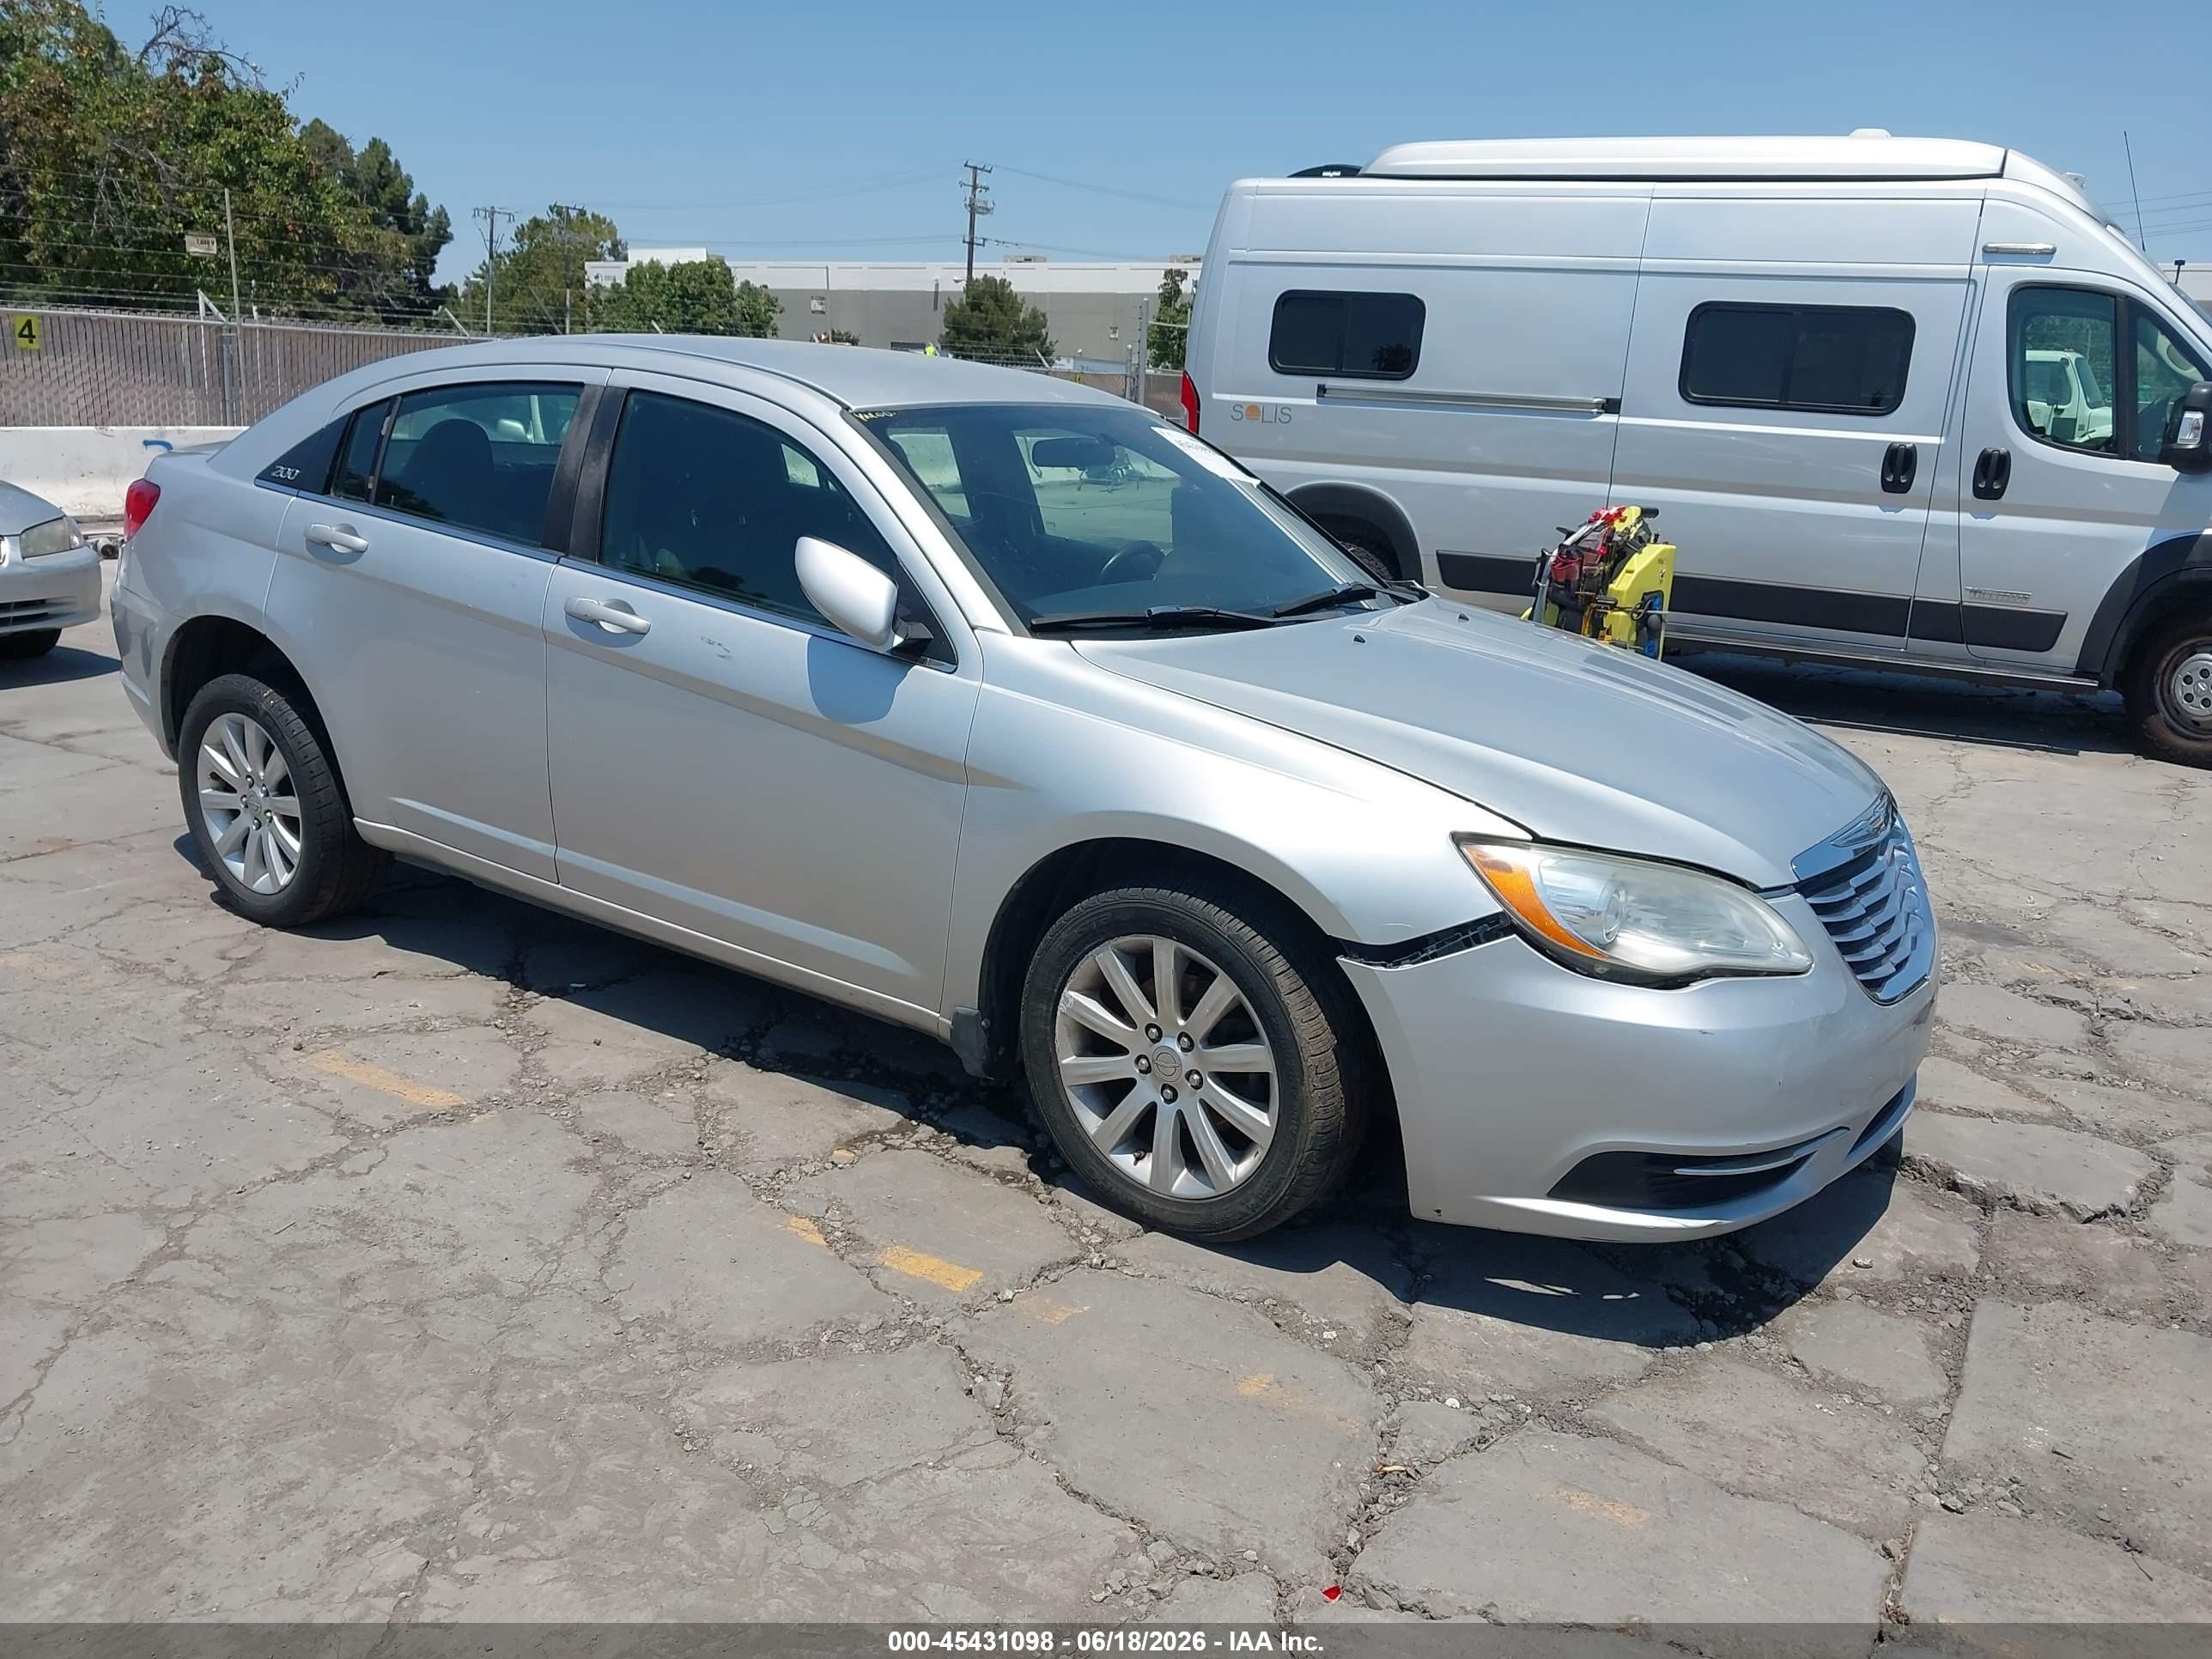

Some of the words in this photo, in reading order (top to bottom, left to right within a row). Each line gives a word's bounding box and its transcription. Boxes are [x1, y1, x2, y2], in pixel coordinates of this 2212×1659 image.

[18, 319, 36, 344] 4
[1230, 404, 1292, 424] SOLIS
[270, 465, 301, 480] 200
